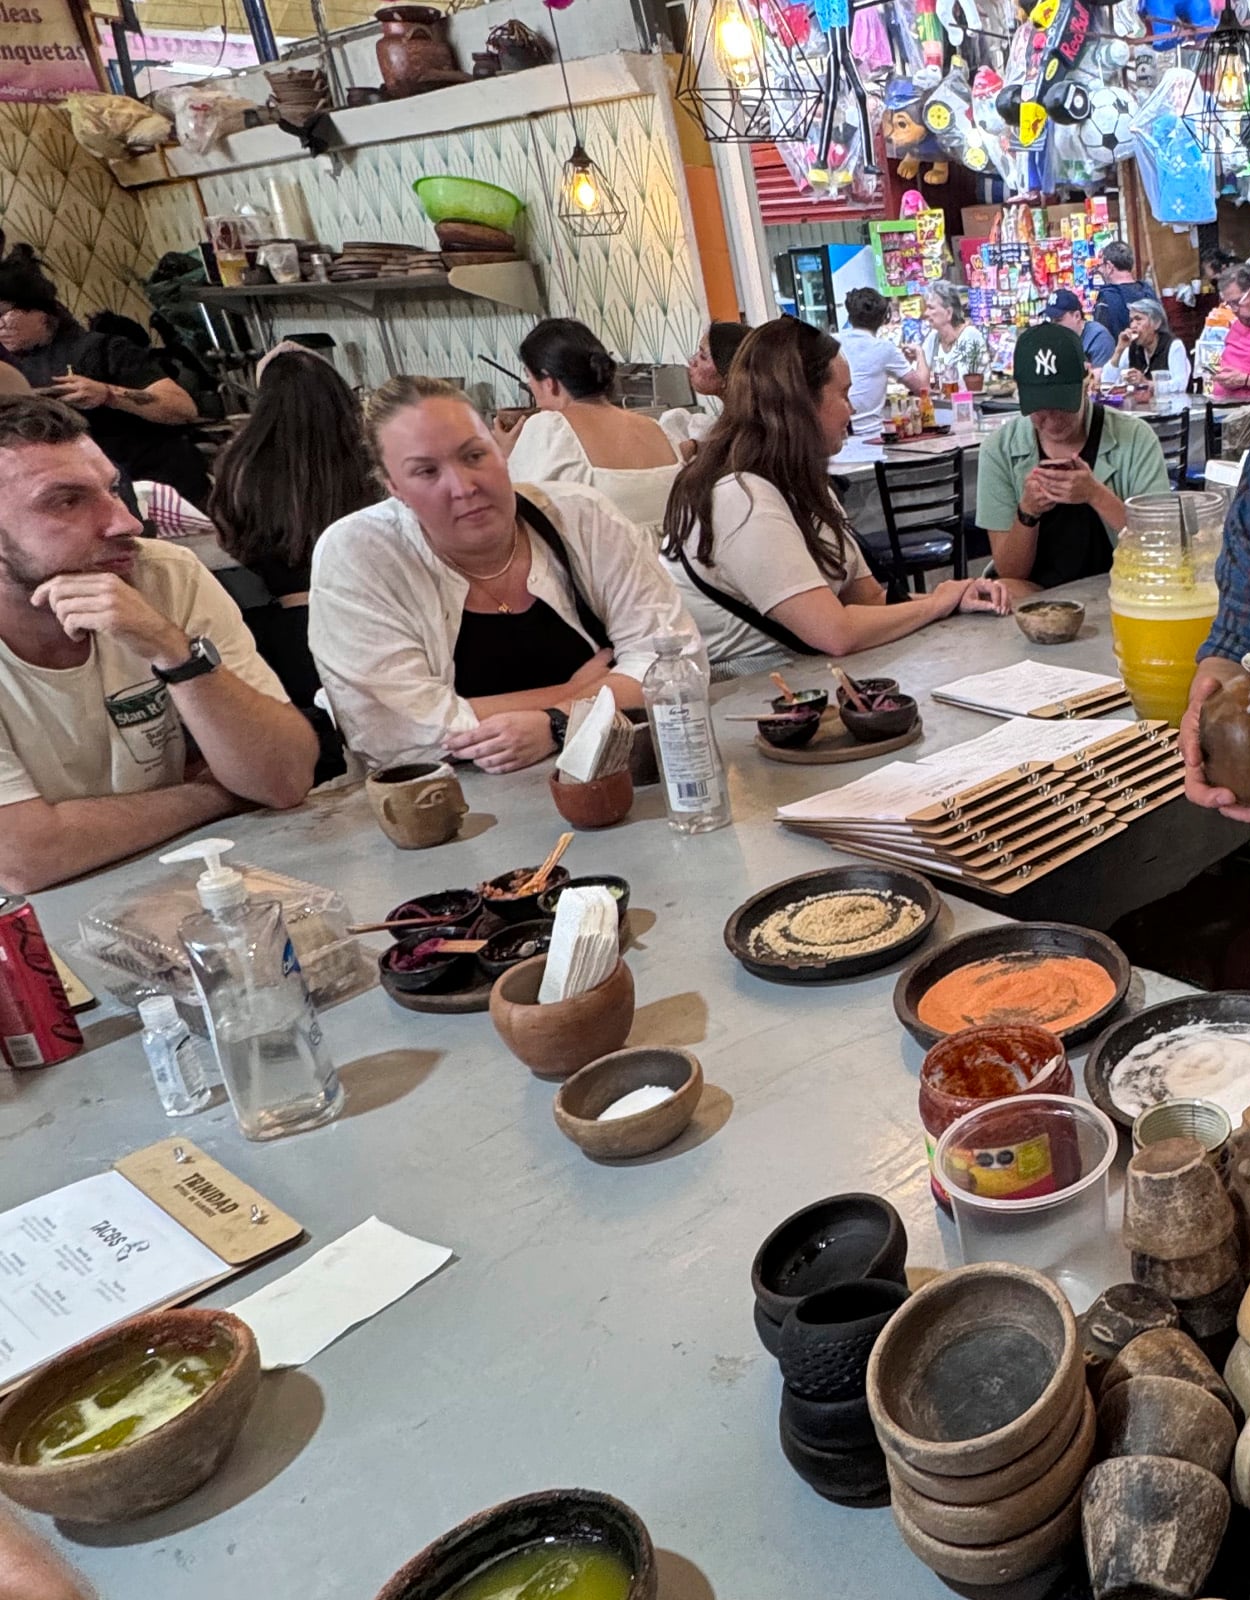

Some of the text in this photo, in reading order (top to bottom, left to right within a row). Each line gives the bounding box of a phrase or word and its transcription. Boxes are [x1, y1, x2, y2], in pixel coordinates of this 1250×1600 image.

[0, 1, 43, 23] leas
[0, 42, 86, 65] nquetas
[1034, 348, 1058, 376] NY
[115, 709, 148, 726] Stan
[181, 1172, 239, 1214] TRINIDAD
[90, 1219, 128, 1248] TACOS
